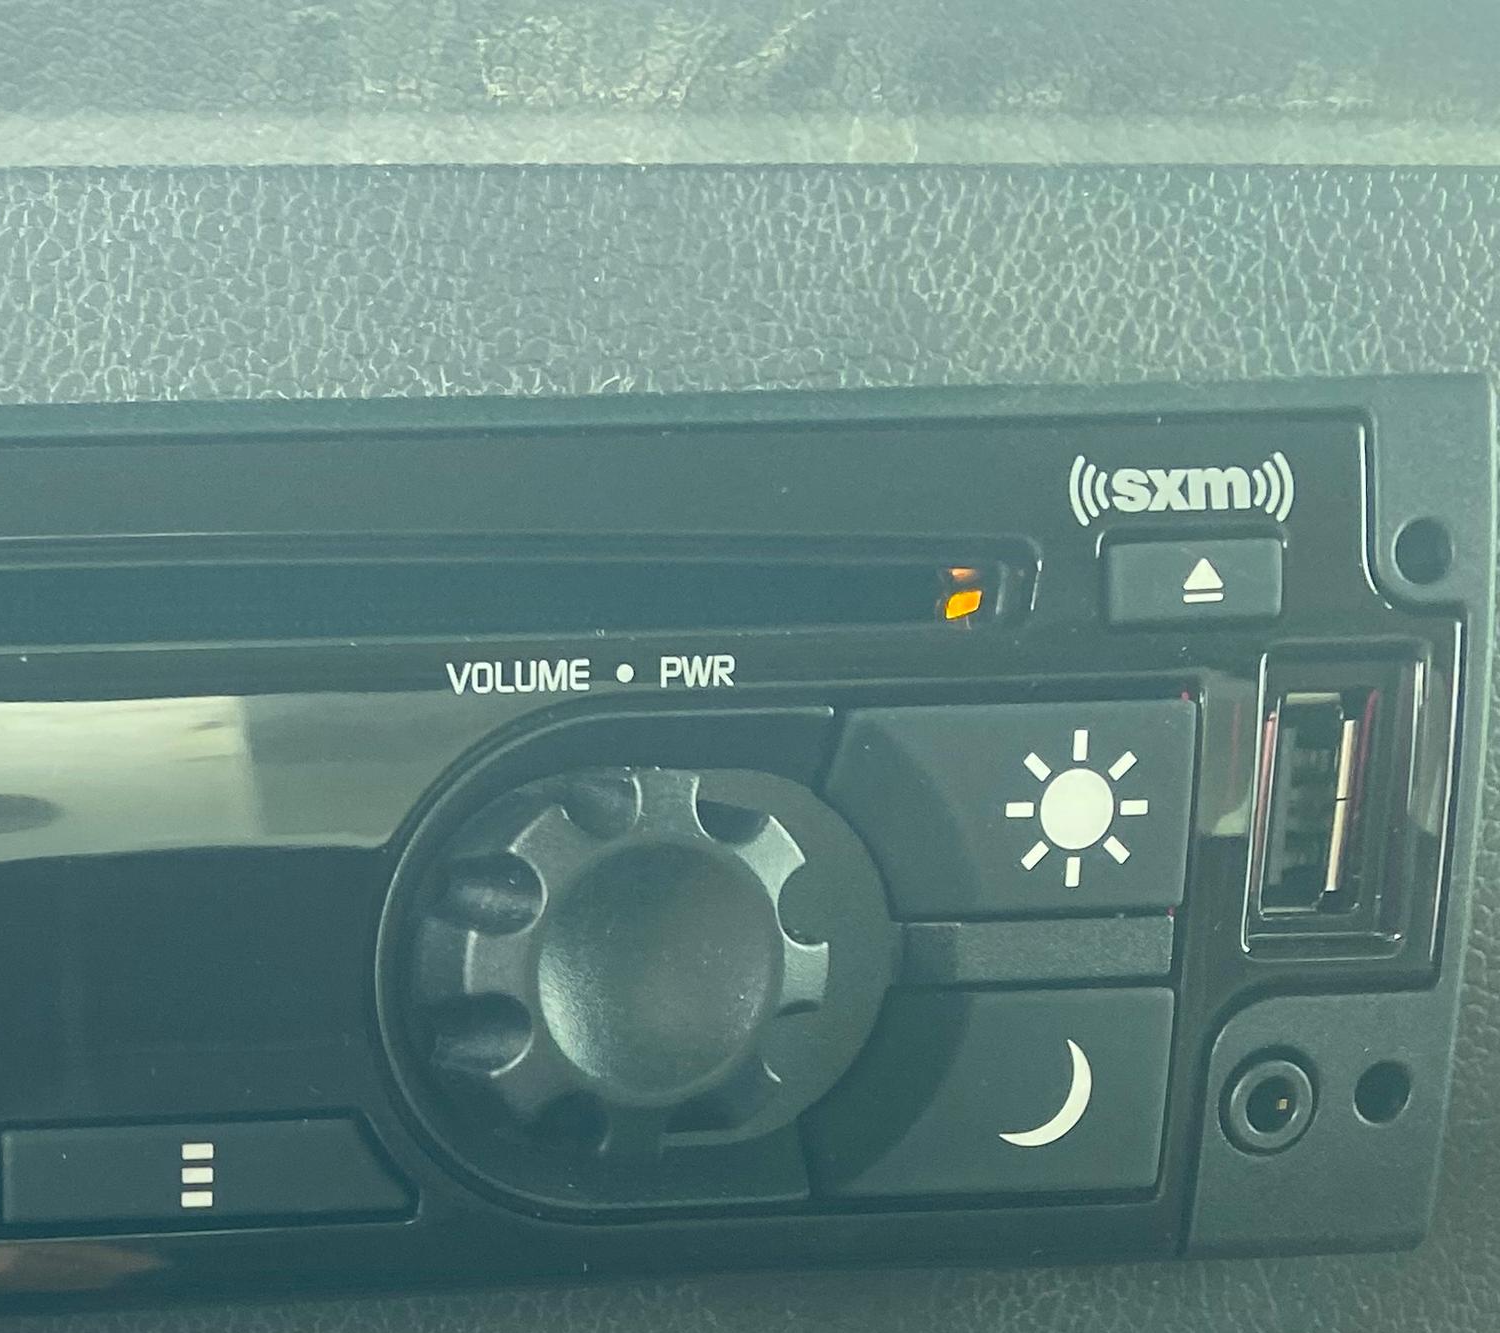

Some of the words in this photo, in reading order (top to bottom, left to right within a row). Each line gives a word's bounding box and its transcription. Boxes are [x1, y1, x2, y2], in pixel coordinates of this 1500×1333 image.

[1111, 464, 1252, 514] sxm
[445, 657, 590, 695] VOLUME
[659, 653, 736, 689] PWR
